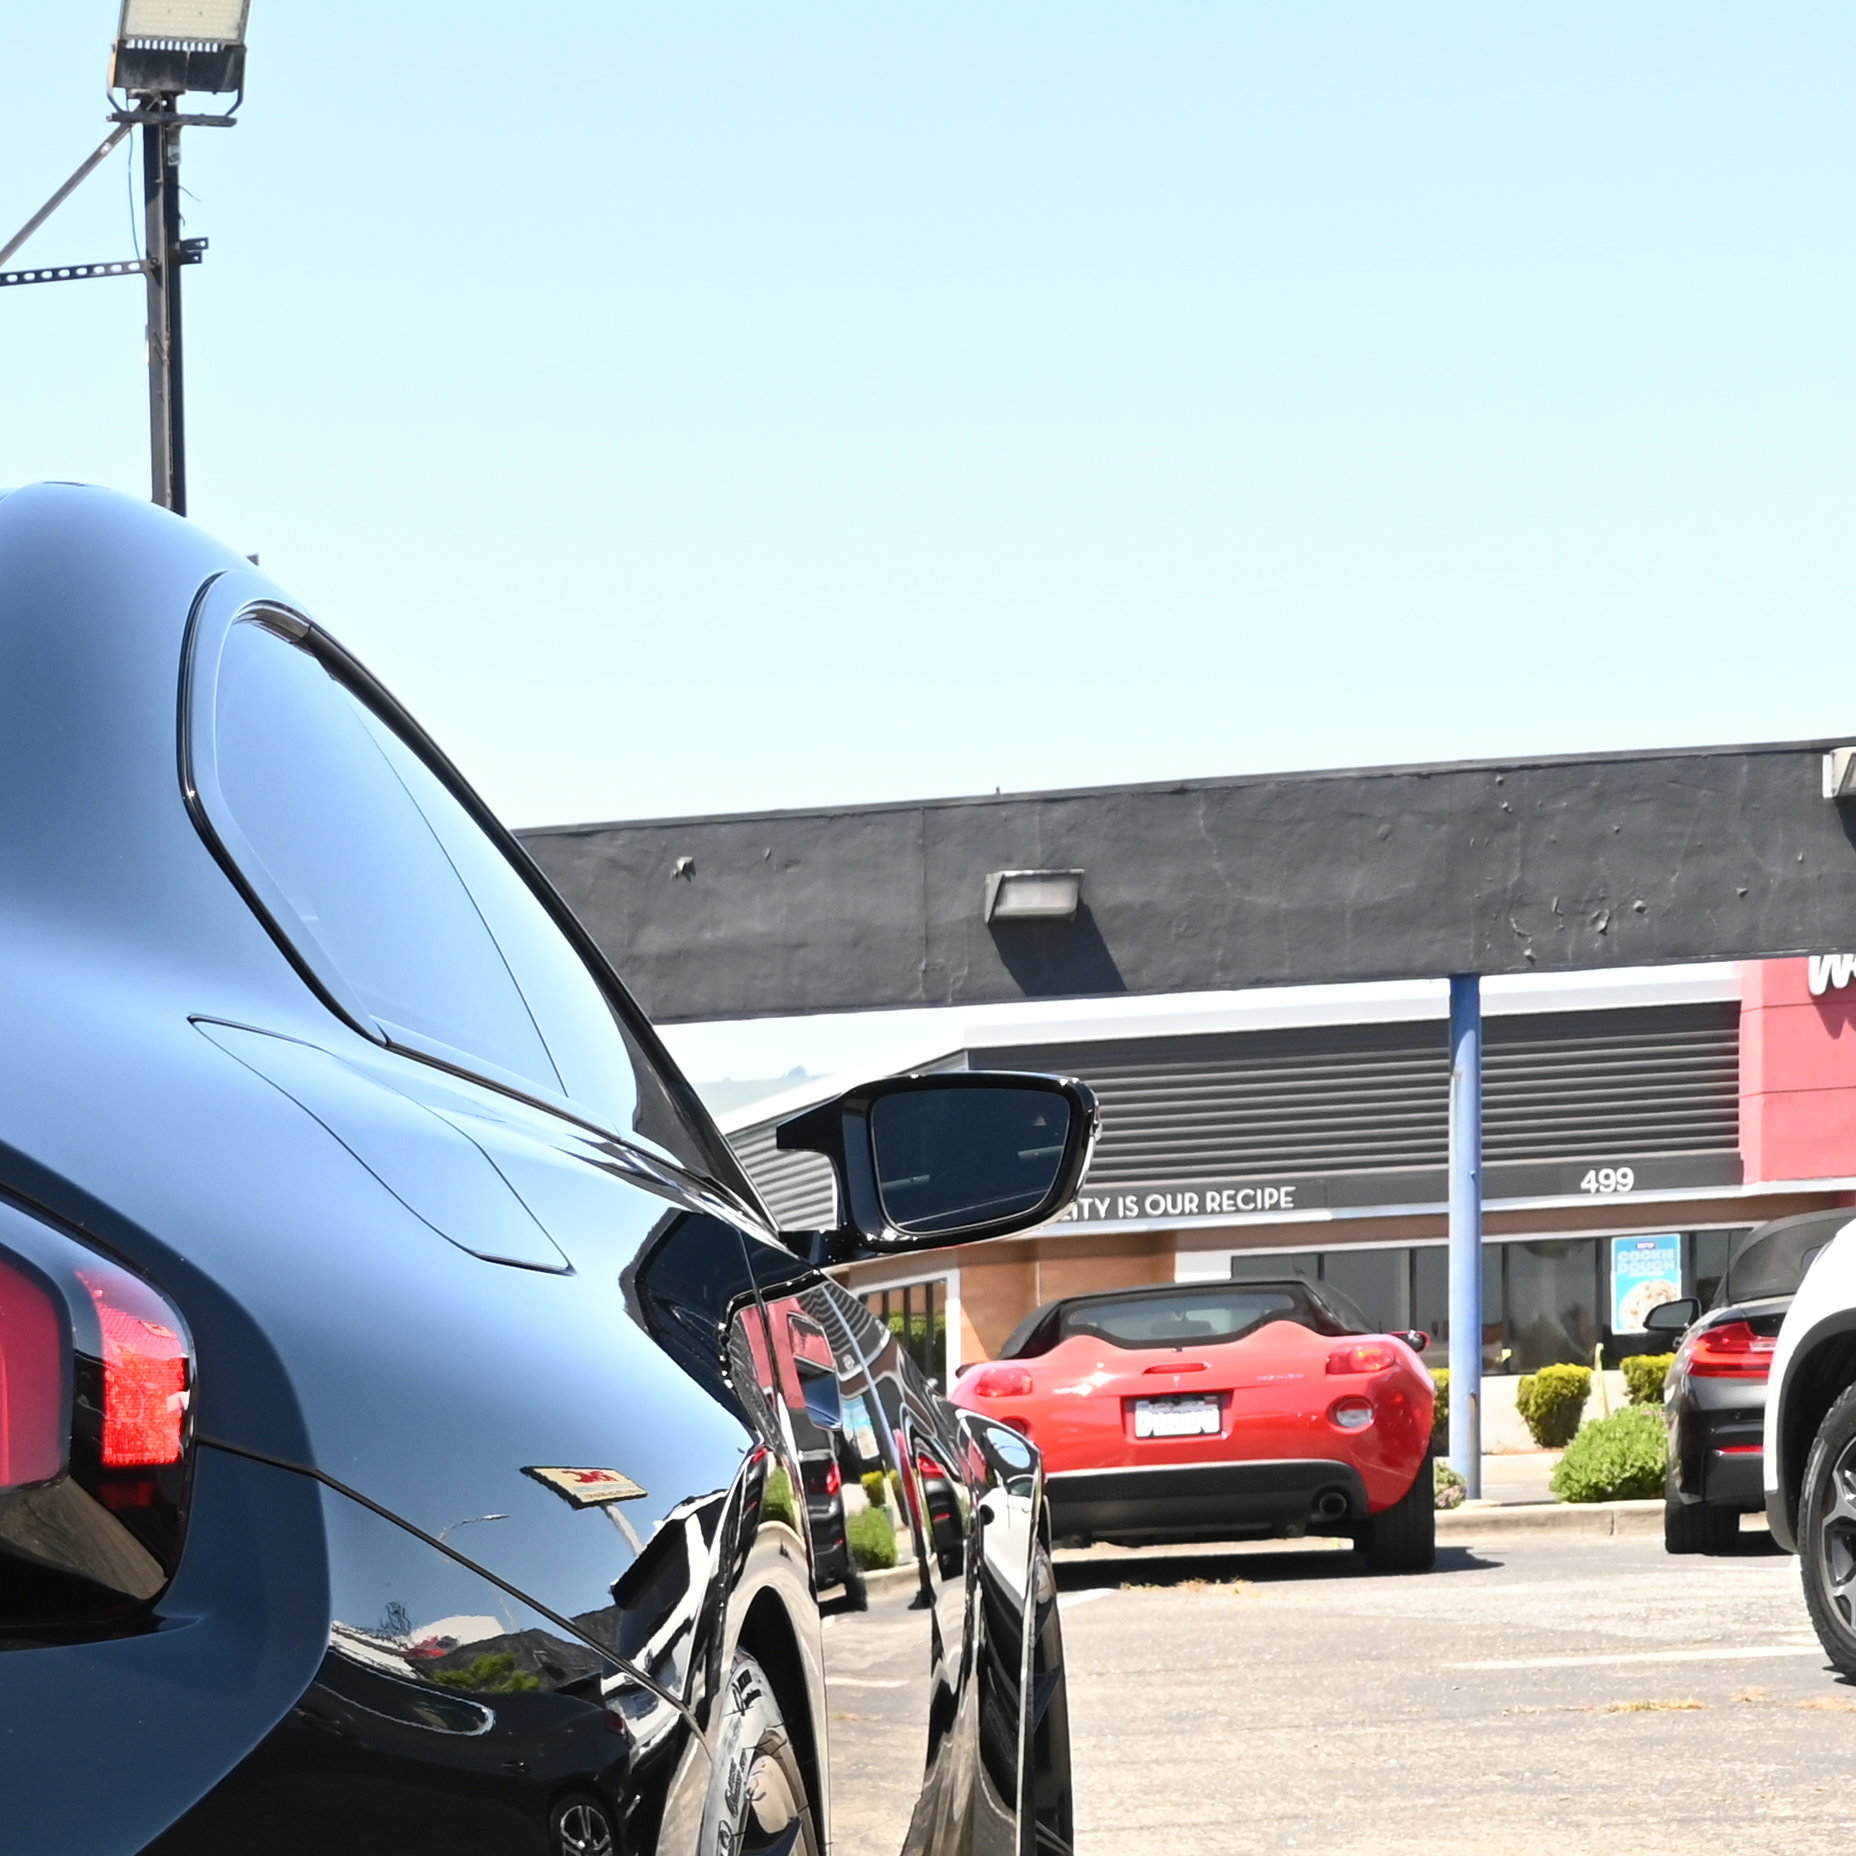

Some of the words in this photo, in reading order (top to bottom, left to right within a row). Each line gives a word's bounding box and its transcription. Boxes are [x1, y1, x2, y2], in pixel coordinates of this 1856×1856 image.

[1580, 1166, 1635, 1194] 499
[1117, 1195, 1139, 1219] IS
[1145, 1191, 1198, 1217] OUR
[1205, 1186, 1297, 1214] RECIPE
